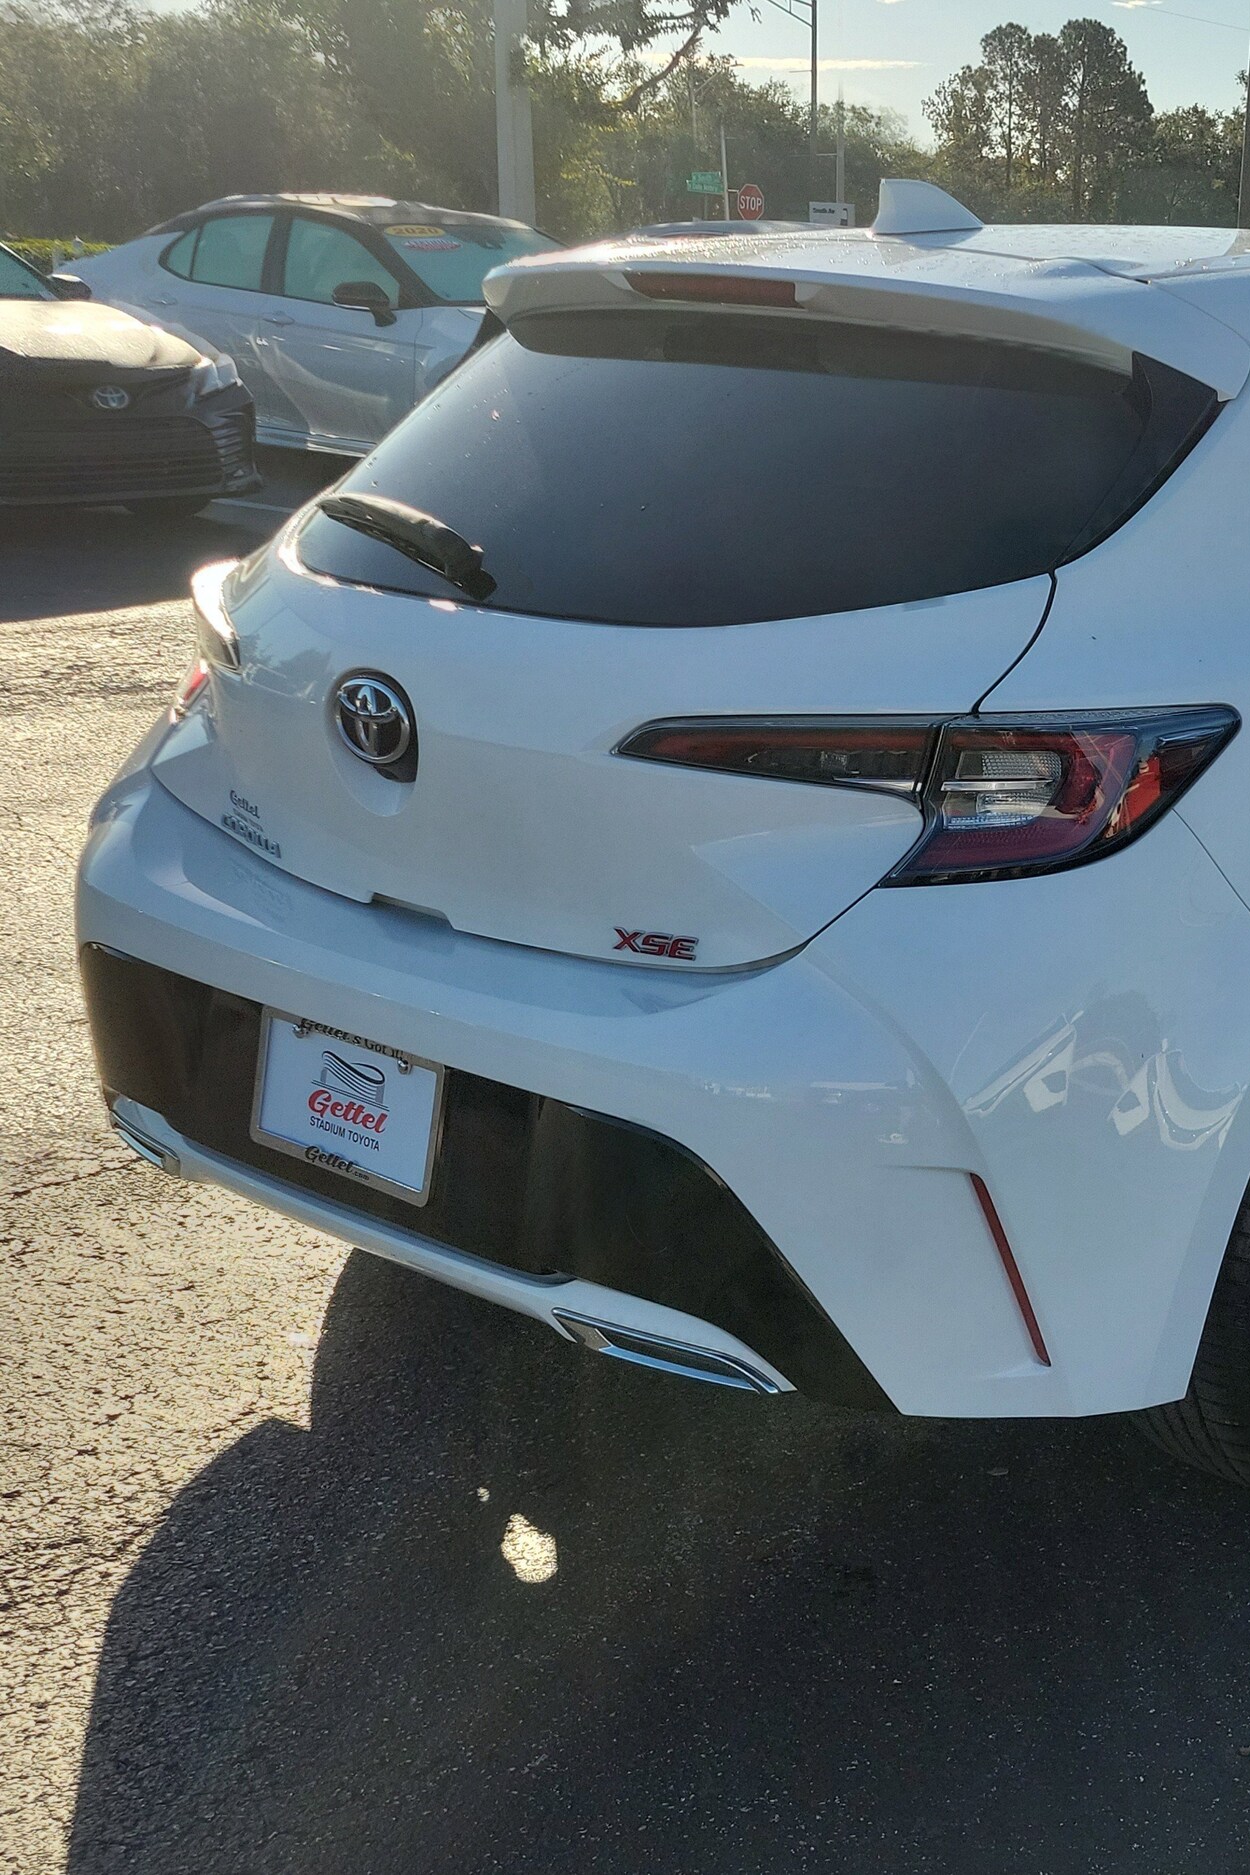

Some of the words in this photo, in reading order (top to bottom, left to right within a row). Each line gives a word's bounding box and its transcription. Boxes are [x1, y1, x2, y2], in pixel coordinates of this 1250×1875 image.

[740, 195, 762, 211] STOP
[392, 227, 439, 235] 2020
[612, 926, 699, 962] XSE
[308, 1089, 388, 1133] Gettel
[310, 1115, 346, 1139] STADIUM
[348, 1129, 380, 1152] TOYOTA
